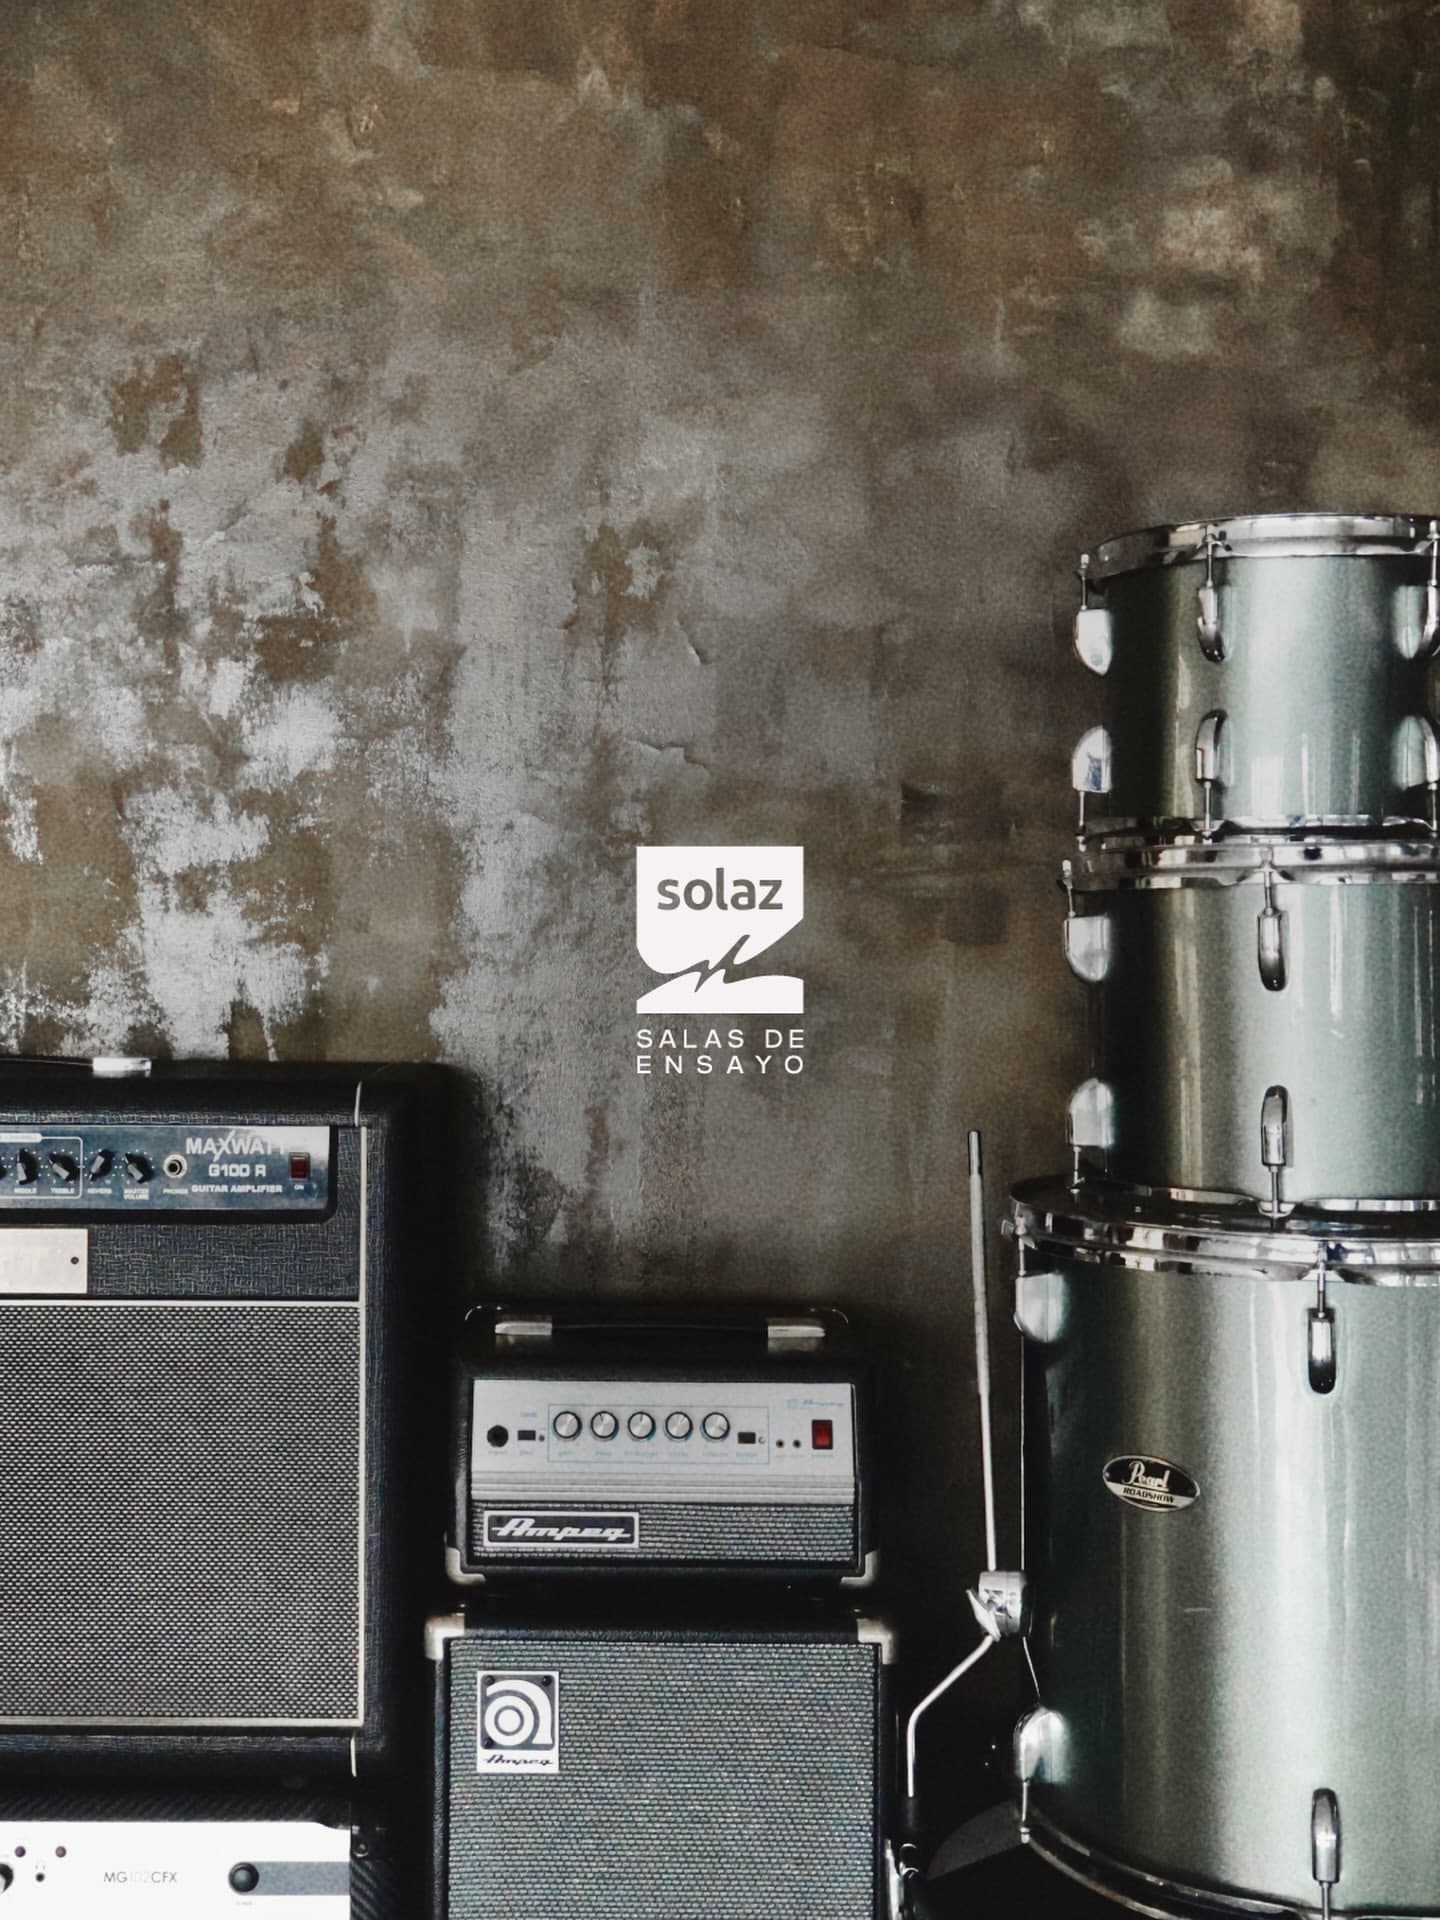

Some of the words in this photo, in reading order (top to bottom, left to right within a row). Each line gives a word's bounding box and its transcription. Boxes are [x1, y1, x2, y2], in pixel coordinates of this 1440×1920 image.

[186, 1130, 285, 1162] MAXWATT
[208, 1164, 250, 1177] G100
[255, 1164, 266, 1177] R
[191, 1184, 228, 1194] GUITAR
[230, 1184, 283, 1194] AMPLIFIER
[1122, 1487, 1175, 1504] ROADSHOW
[491, 1518, 631, 1541] Ampeg
